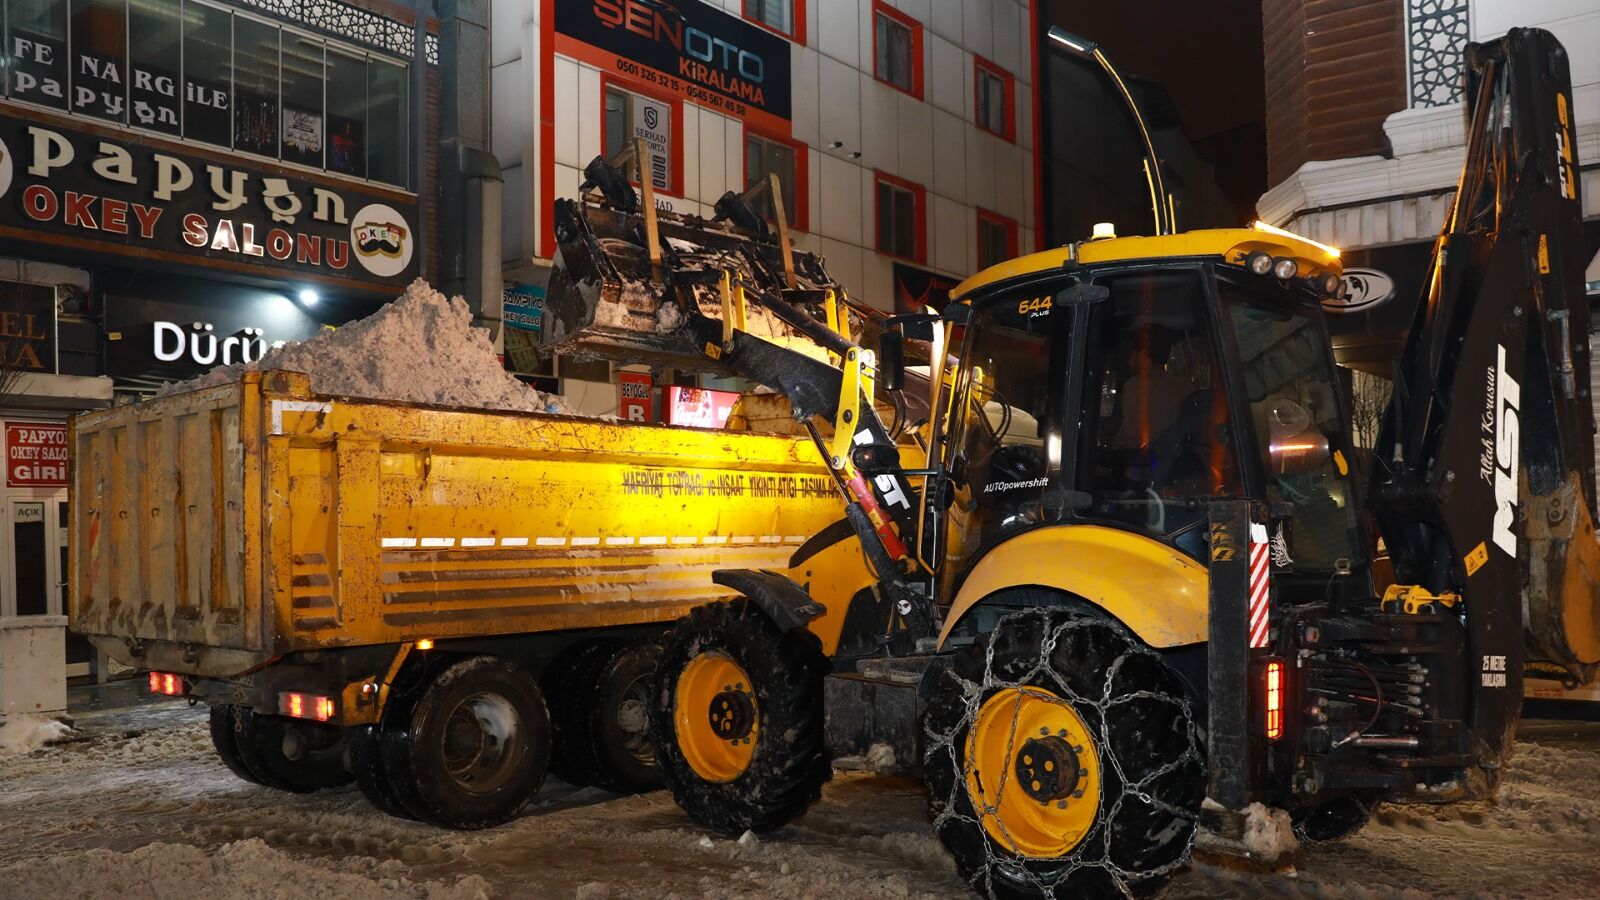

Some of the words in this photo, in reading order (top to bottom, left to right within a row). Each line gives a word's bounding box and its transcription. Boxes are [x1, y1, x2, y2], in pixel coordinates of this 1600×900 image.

[617, 59, 639, 76] 0501
[641, 69, 656, 82] 326
[658, 76, 669, 87] 32
[671, 80, 680, 91] 15
[709, 94, 723, 107] 567
[725, 101, 734, 112] 45
[635, 127, 666, 145] SERHAD
[647, 141, 666, 154] ORTA
[23, 184, 163, 239] OKEY
[182, 213, 349, 270] SALONU
[1018, 295, 1052, 314] 644
[520, 313, 540, 326] SALO
[154, 321, 300, 366] Dürü
[1481, 365, 1495, 434] Korusun
[19, 430, 67, 444] PAPYO
[11, 446, 40, 460] OKEY
[42, 447, 67, 461] SALO
[1492, 343, 1520, 559] MST
[14, 462, 66, 480] GİRİ
[1480, 438, 1493, 486] Allah
[983, 477, 1049, 493] AUTOpowershift
[1482, 655, 1490, 671] 25
